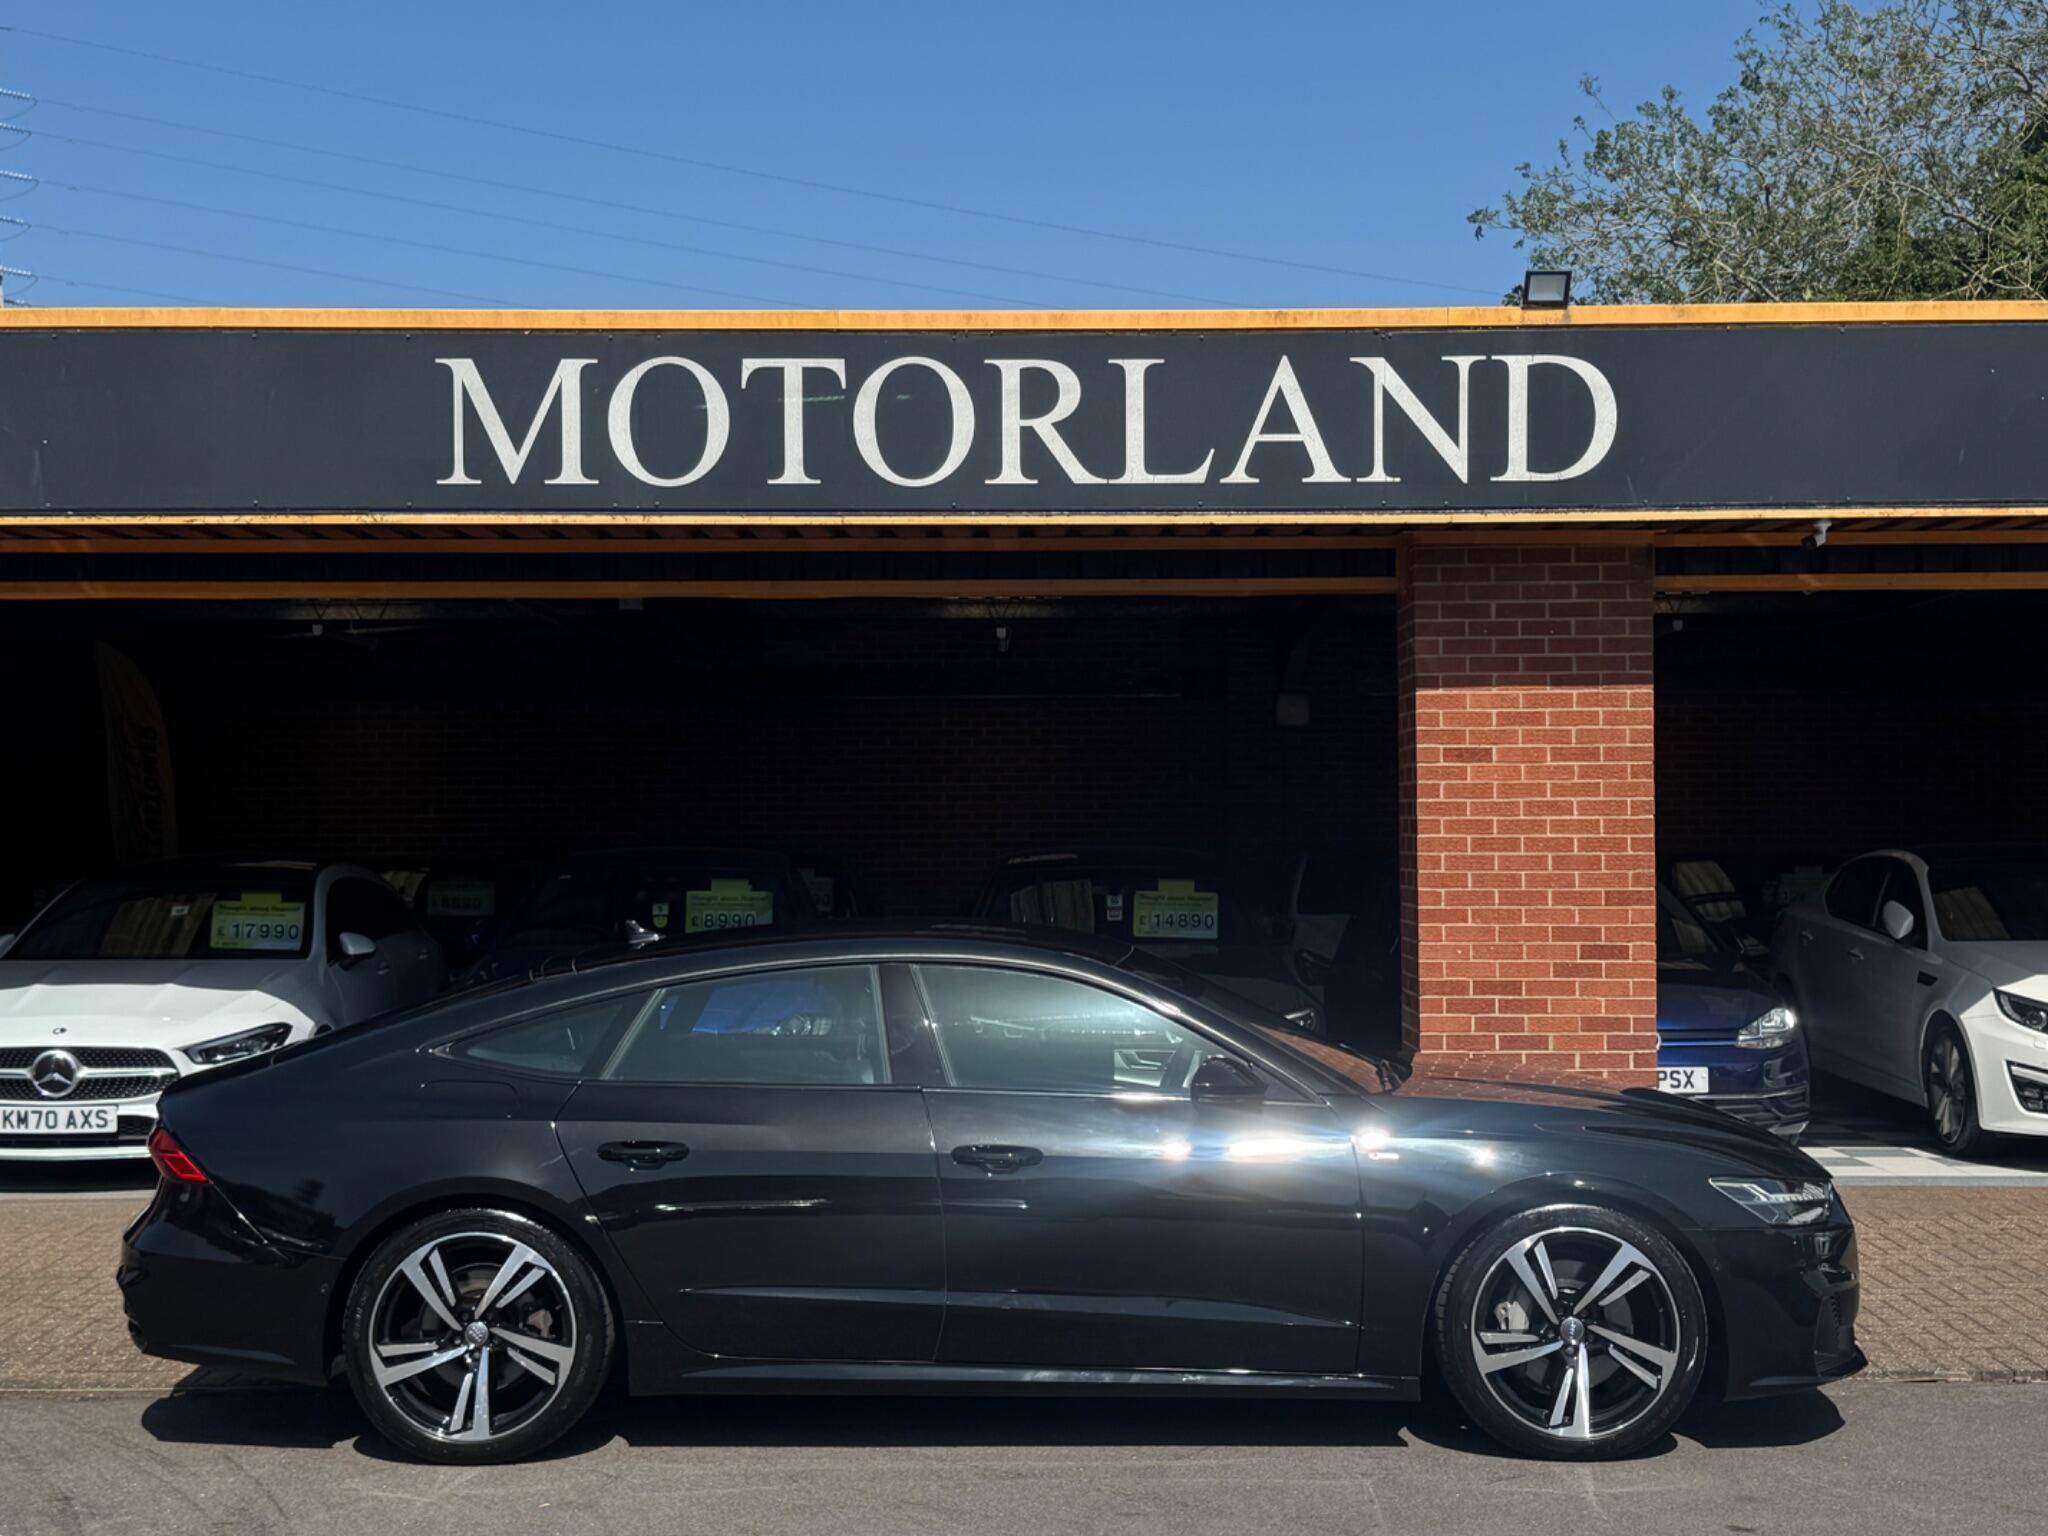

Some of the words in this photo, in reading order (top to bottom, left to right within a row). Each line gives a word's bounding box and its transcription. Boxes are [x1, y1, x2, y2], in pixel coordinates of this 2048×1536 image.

[434, 354, 1619, 487] MOTORLAND
[704, 912, 756, 929] 8990
[1153, 913, 1215, 929] 14890
[232, 923, 299, 939] 17990
[1657, 1070, 1695, 1089] PSX
[2, 1109, 59, 1130] KM70
[66, 1109, 109, 1130] AXS
